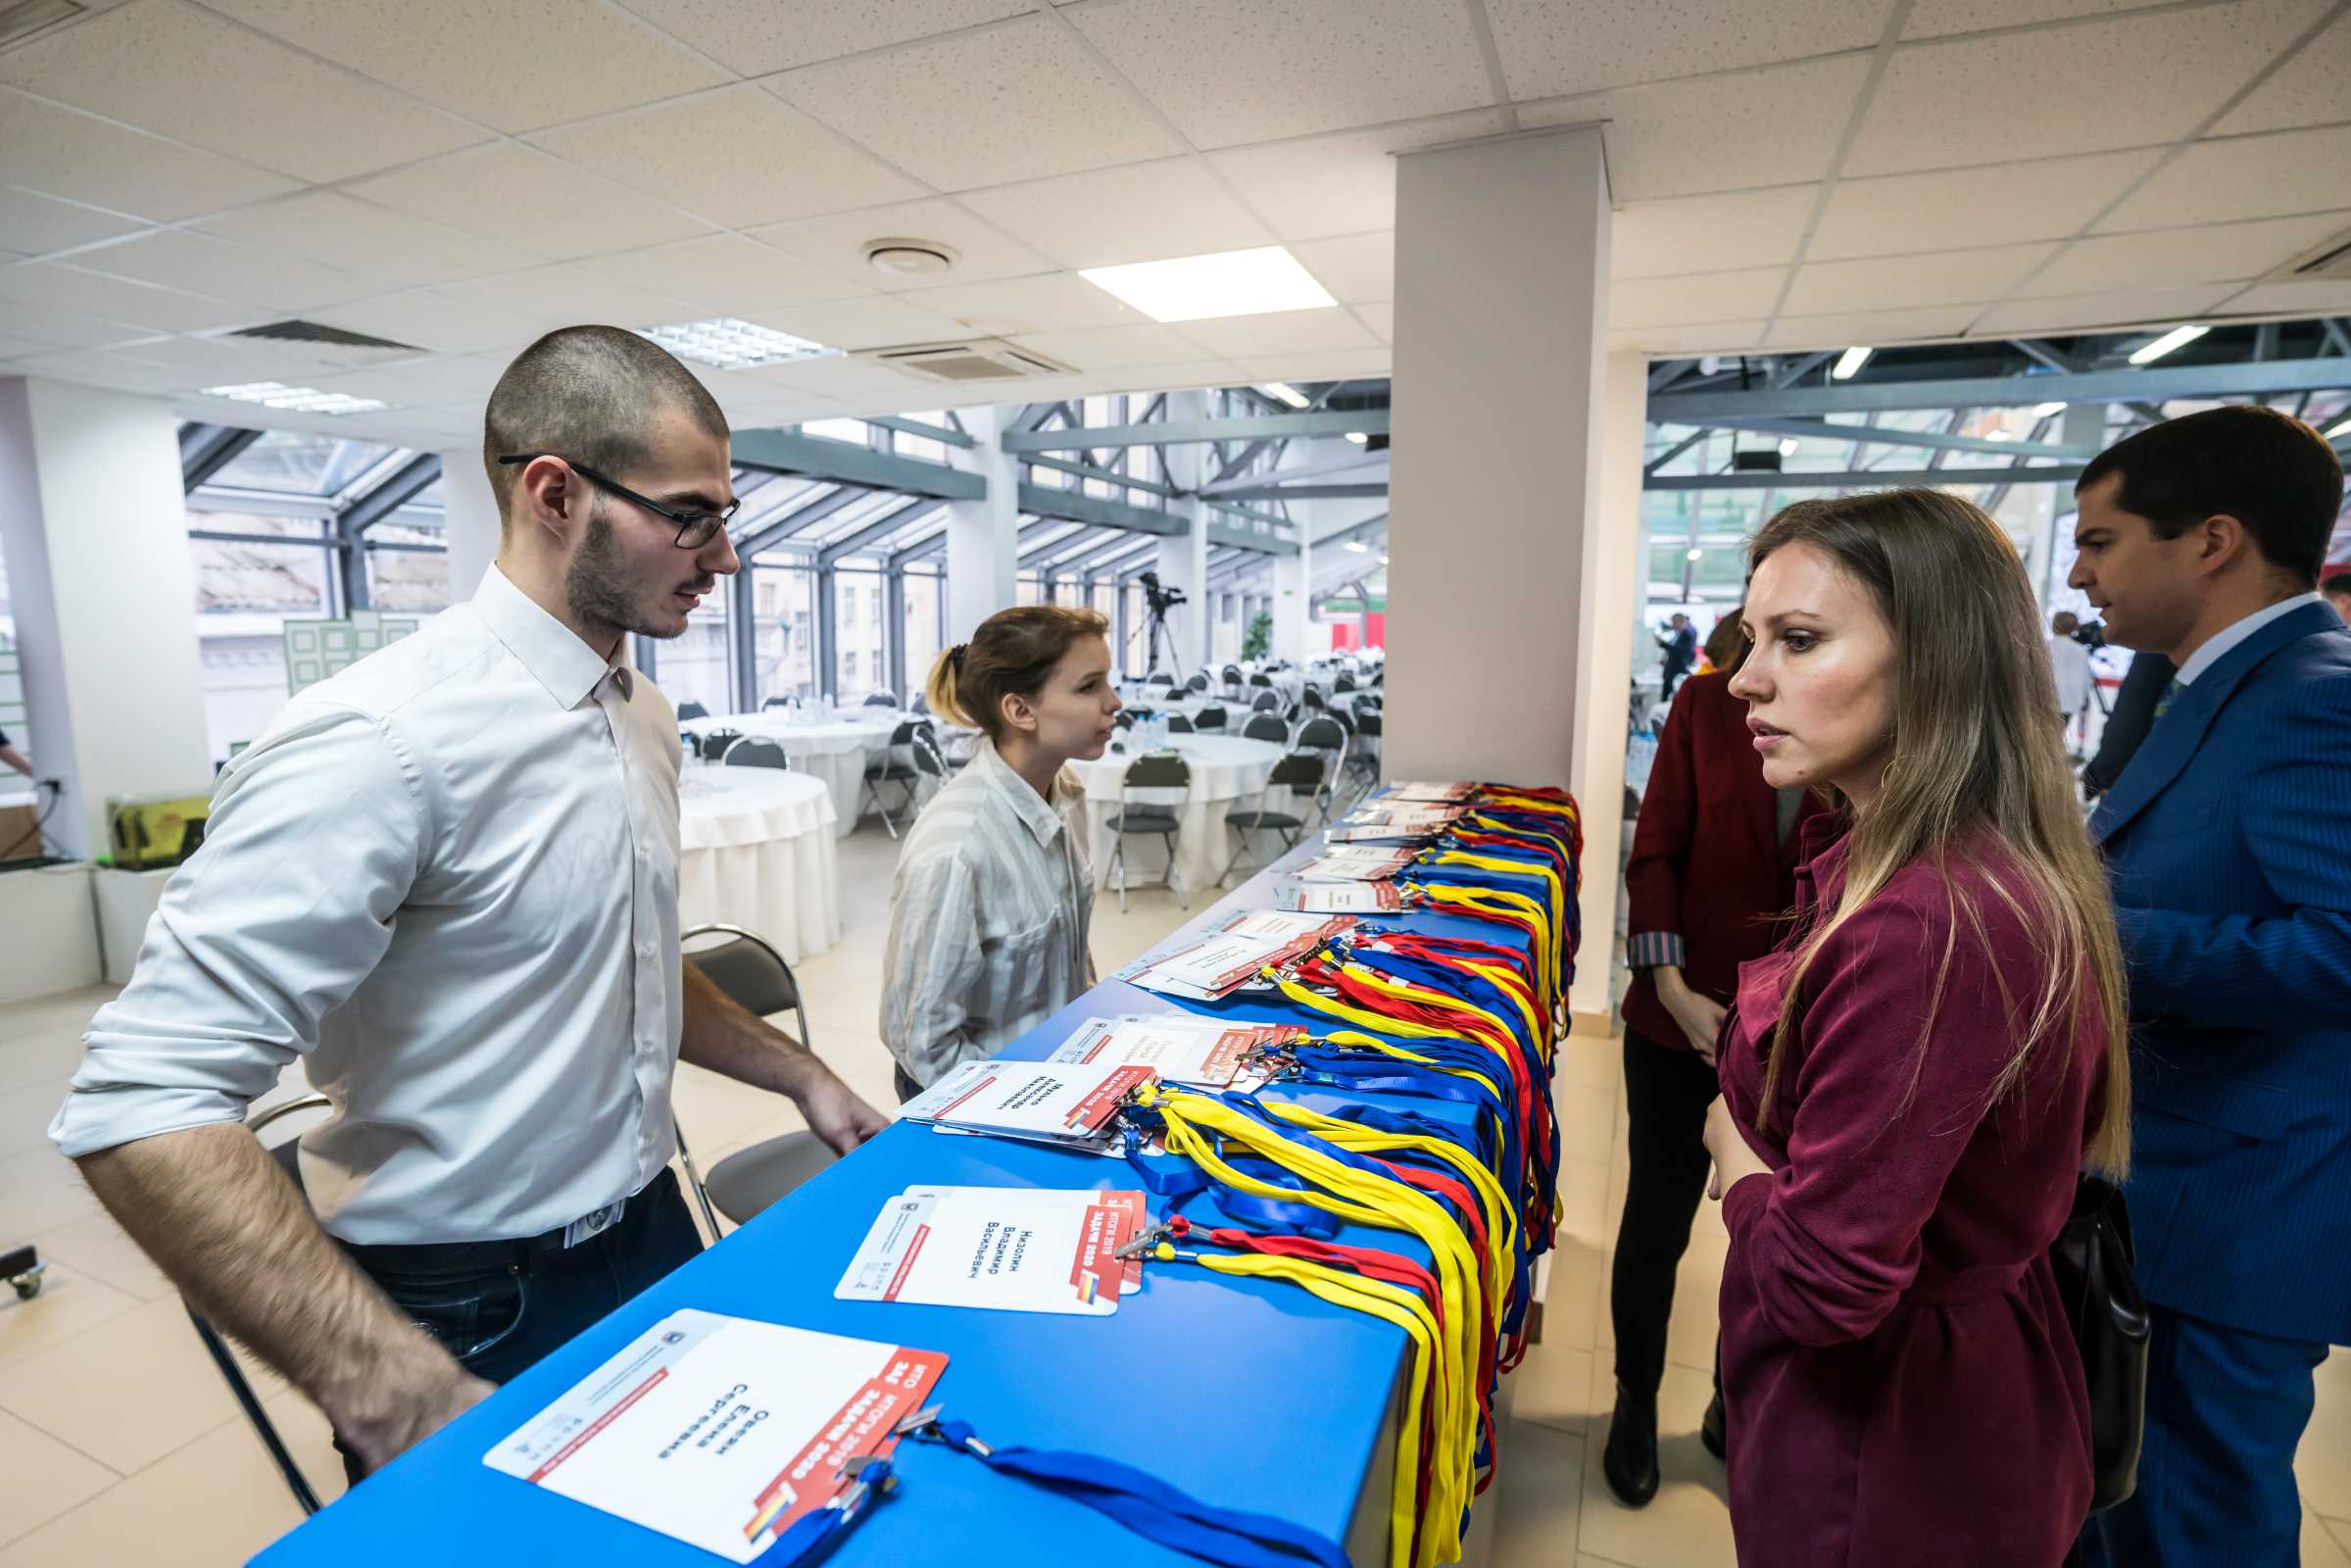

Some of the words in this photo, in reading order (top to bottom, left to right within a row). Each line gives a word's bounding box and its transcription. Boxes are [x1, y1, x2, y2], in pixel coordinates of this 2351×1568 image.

[1011, 1078, 1056, 1109] Александр
[1088, 1210, 1104, 1242] ЗАДАЧИ
[968, 1221, 1000, 1279] Васильевич
[988, 1226, 1015, 1275] Владимир
[1009, 1230, 1033, 1272] Низолин
[1083, 1242, 1097, 1266] 2020
[658, 1383, 748, 1459] Сергеевна
[697, 1403, 751, 1448] Елена
[828, 1390, 881, 1443] ЗАДАЧИ
[856, 1394, 898, 1434] ИТОГИ
[792, 1441, 830, 1480] 2020
